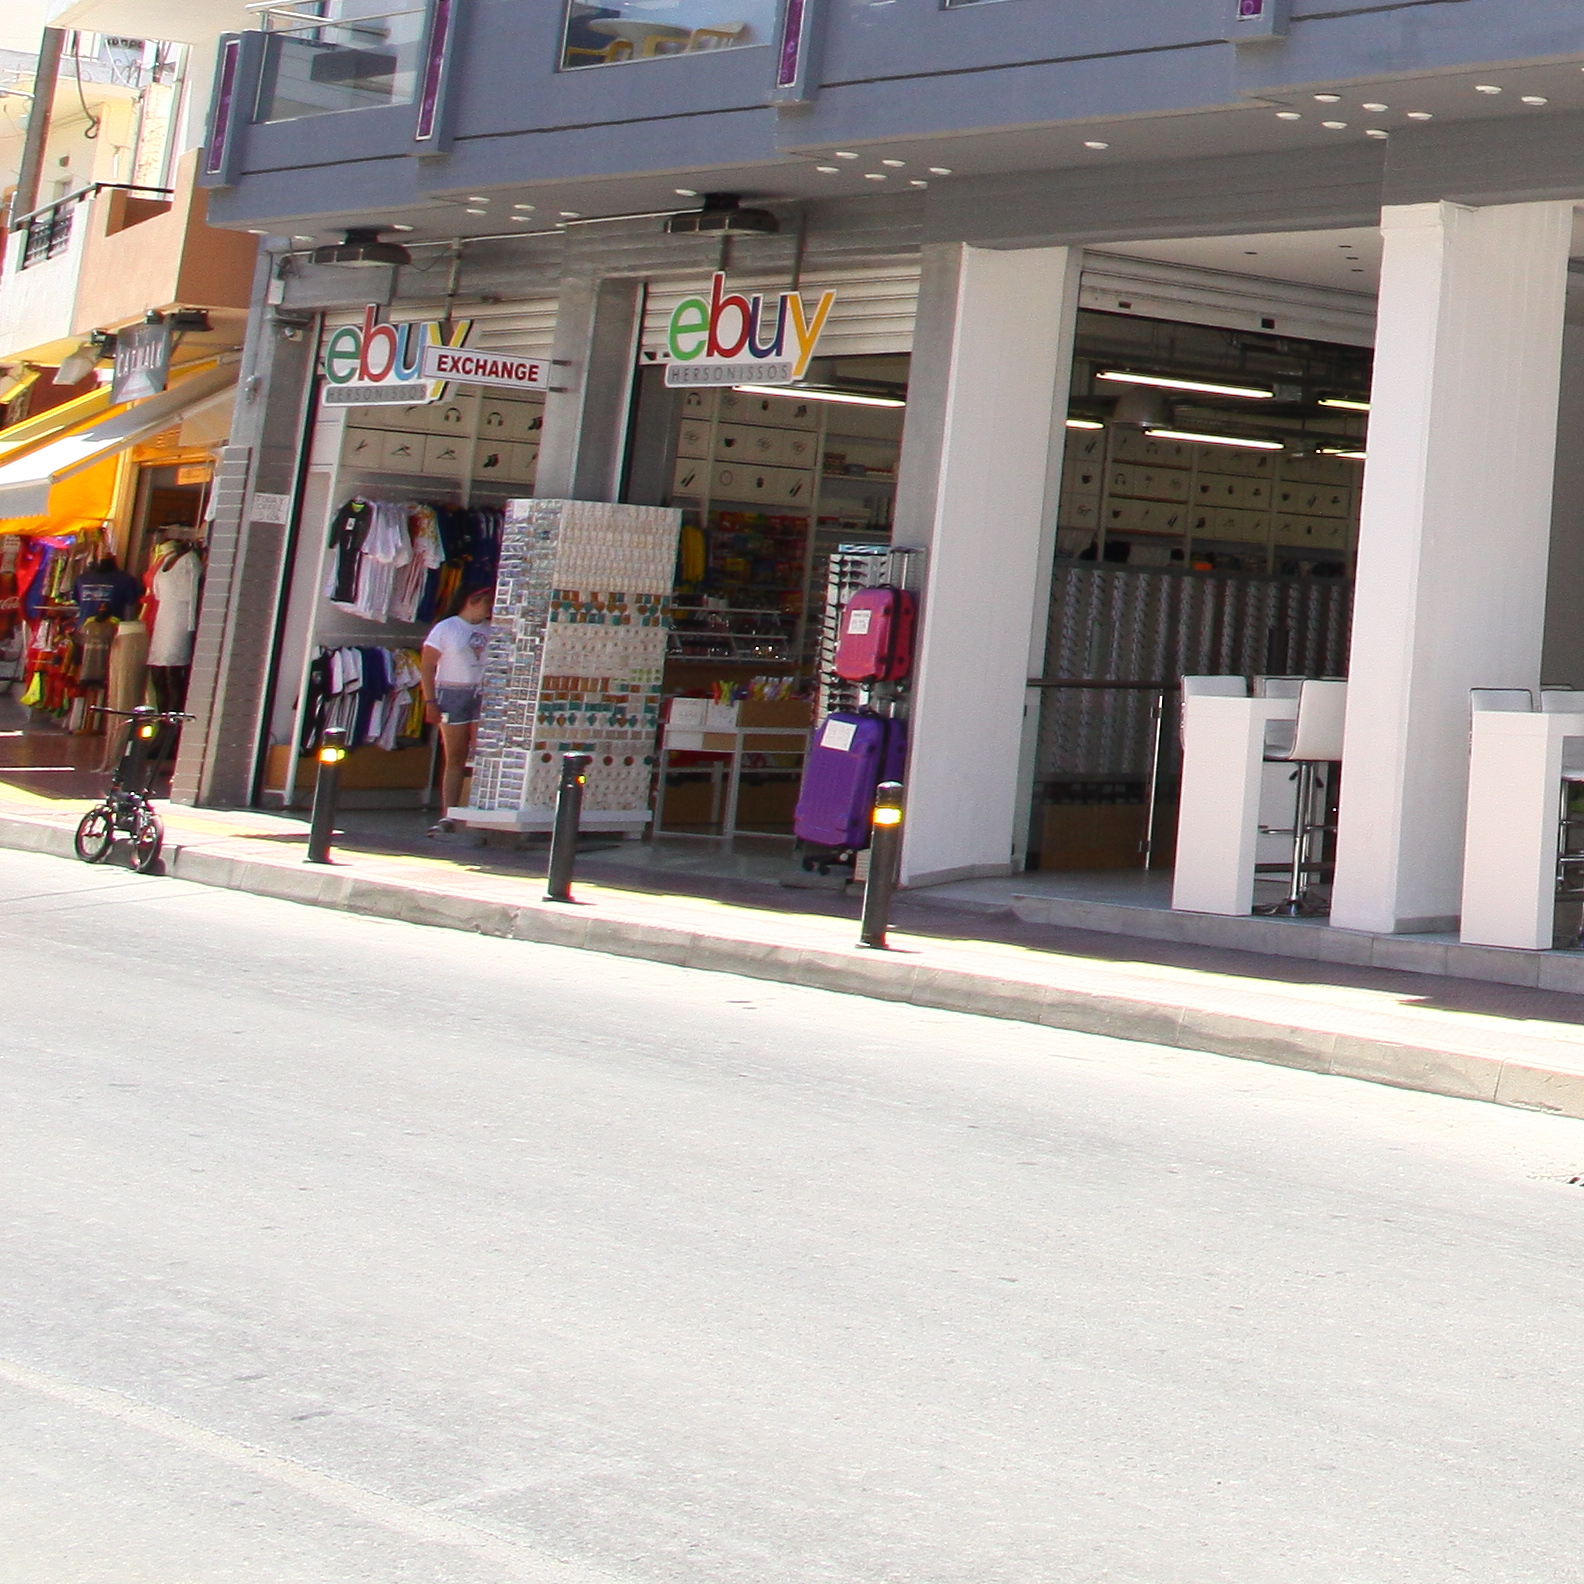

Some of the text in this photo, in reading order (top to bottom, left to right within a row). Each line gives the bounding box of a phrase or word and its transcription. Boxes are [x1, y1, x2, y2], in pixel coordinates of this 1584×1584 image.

[668, 273, 837, 378] ebuy
[437, 354, 540, 382] EXCHANGE
[671, 365, 789, 382] HERSONISSOS
